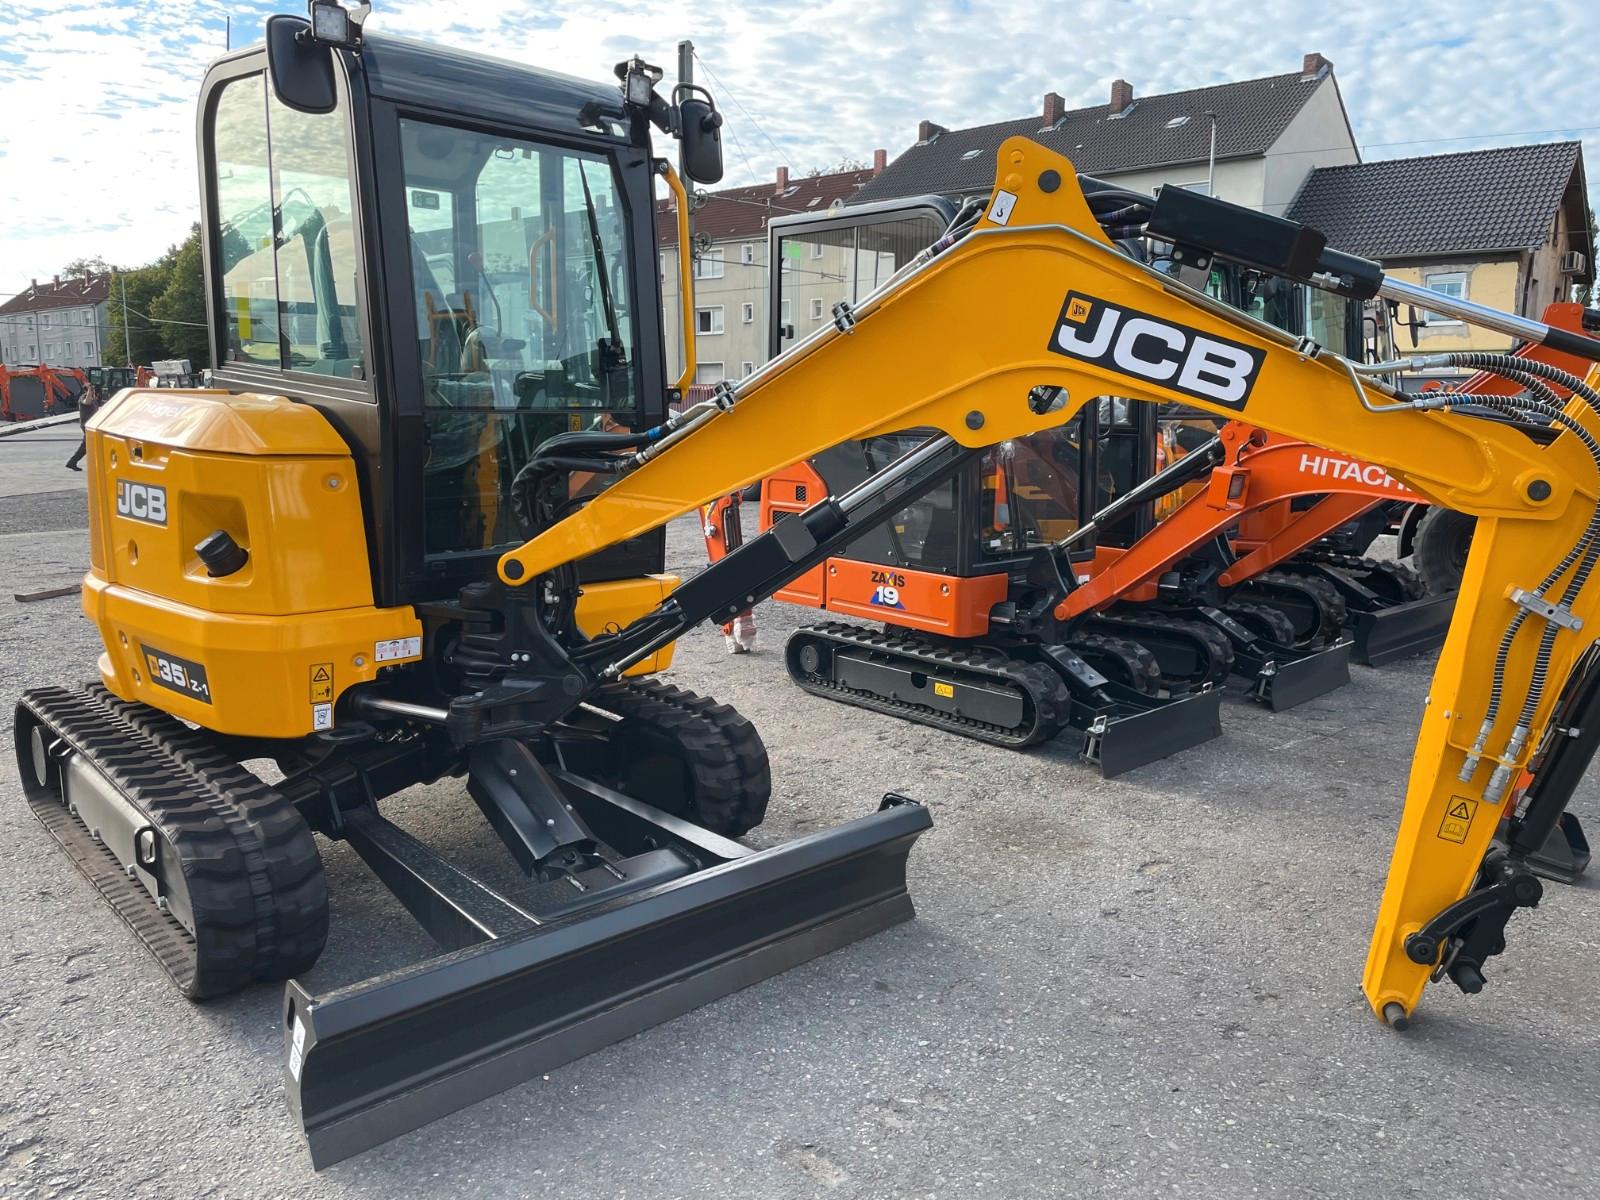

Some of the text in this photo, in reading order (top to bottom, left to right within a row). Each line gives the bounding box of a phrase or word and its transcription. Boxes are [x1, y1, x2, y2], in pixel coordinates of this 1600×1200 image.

[1058, 307, 1254, 402] JCB
[118, 483, 166, 522] JCB
[871, 571, 905, 587] ZAXIS
[876, 585, 899, 605] 19
[158, 658, 186, 687] 35
